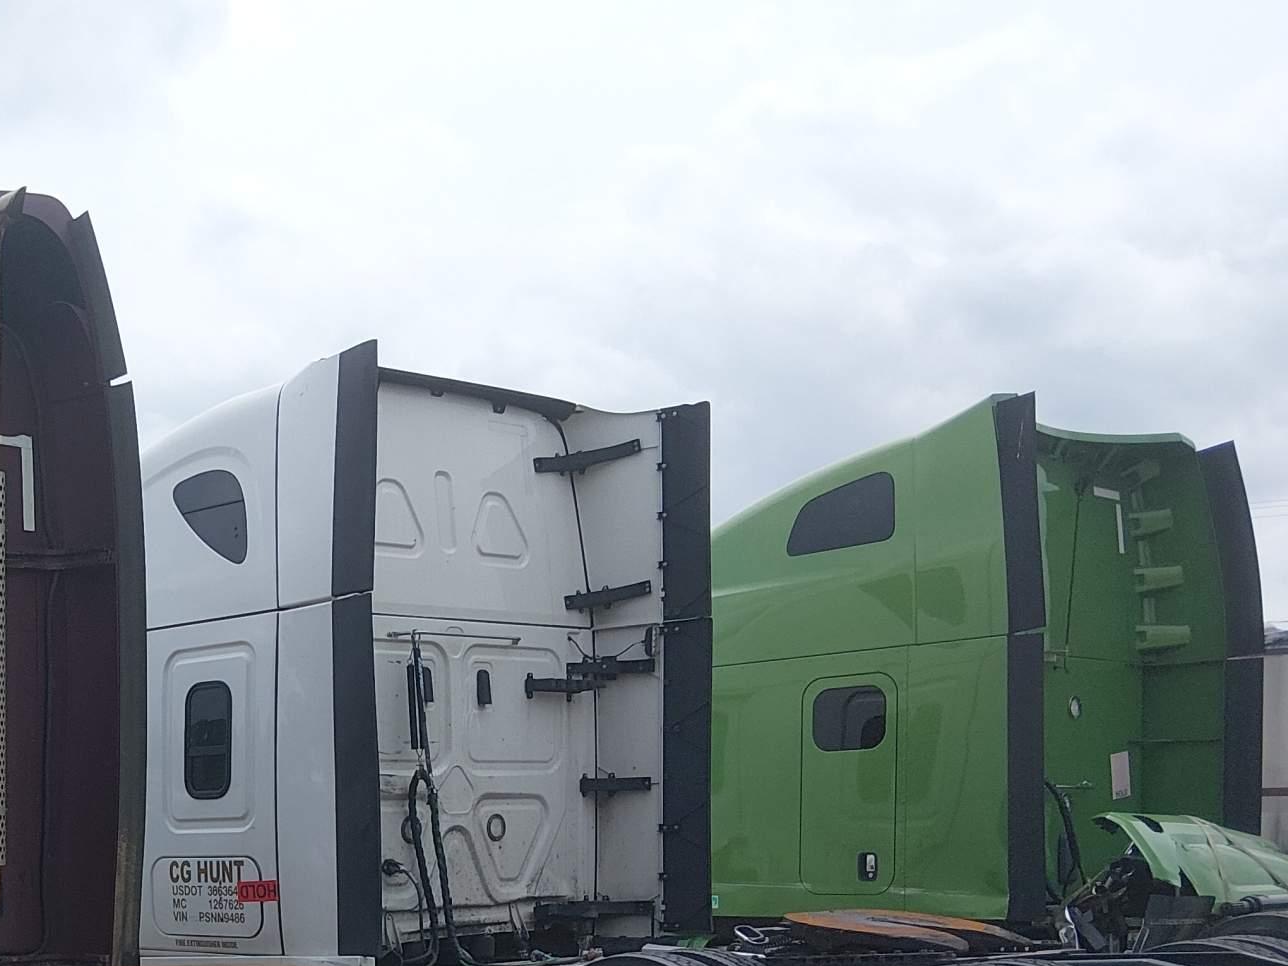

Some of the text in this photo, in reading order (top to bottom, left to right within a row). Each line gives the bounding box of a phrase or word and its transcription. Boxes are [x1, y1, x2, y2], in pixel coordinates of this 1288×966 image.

[169, 860, 245, 884] CG HUNT
[172, 885, 203, 896] USDOT
[240, 883, 277, 899] HOLD
[172, 899, 187, 909] MC
[172, 911, 188, 923] VIN
